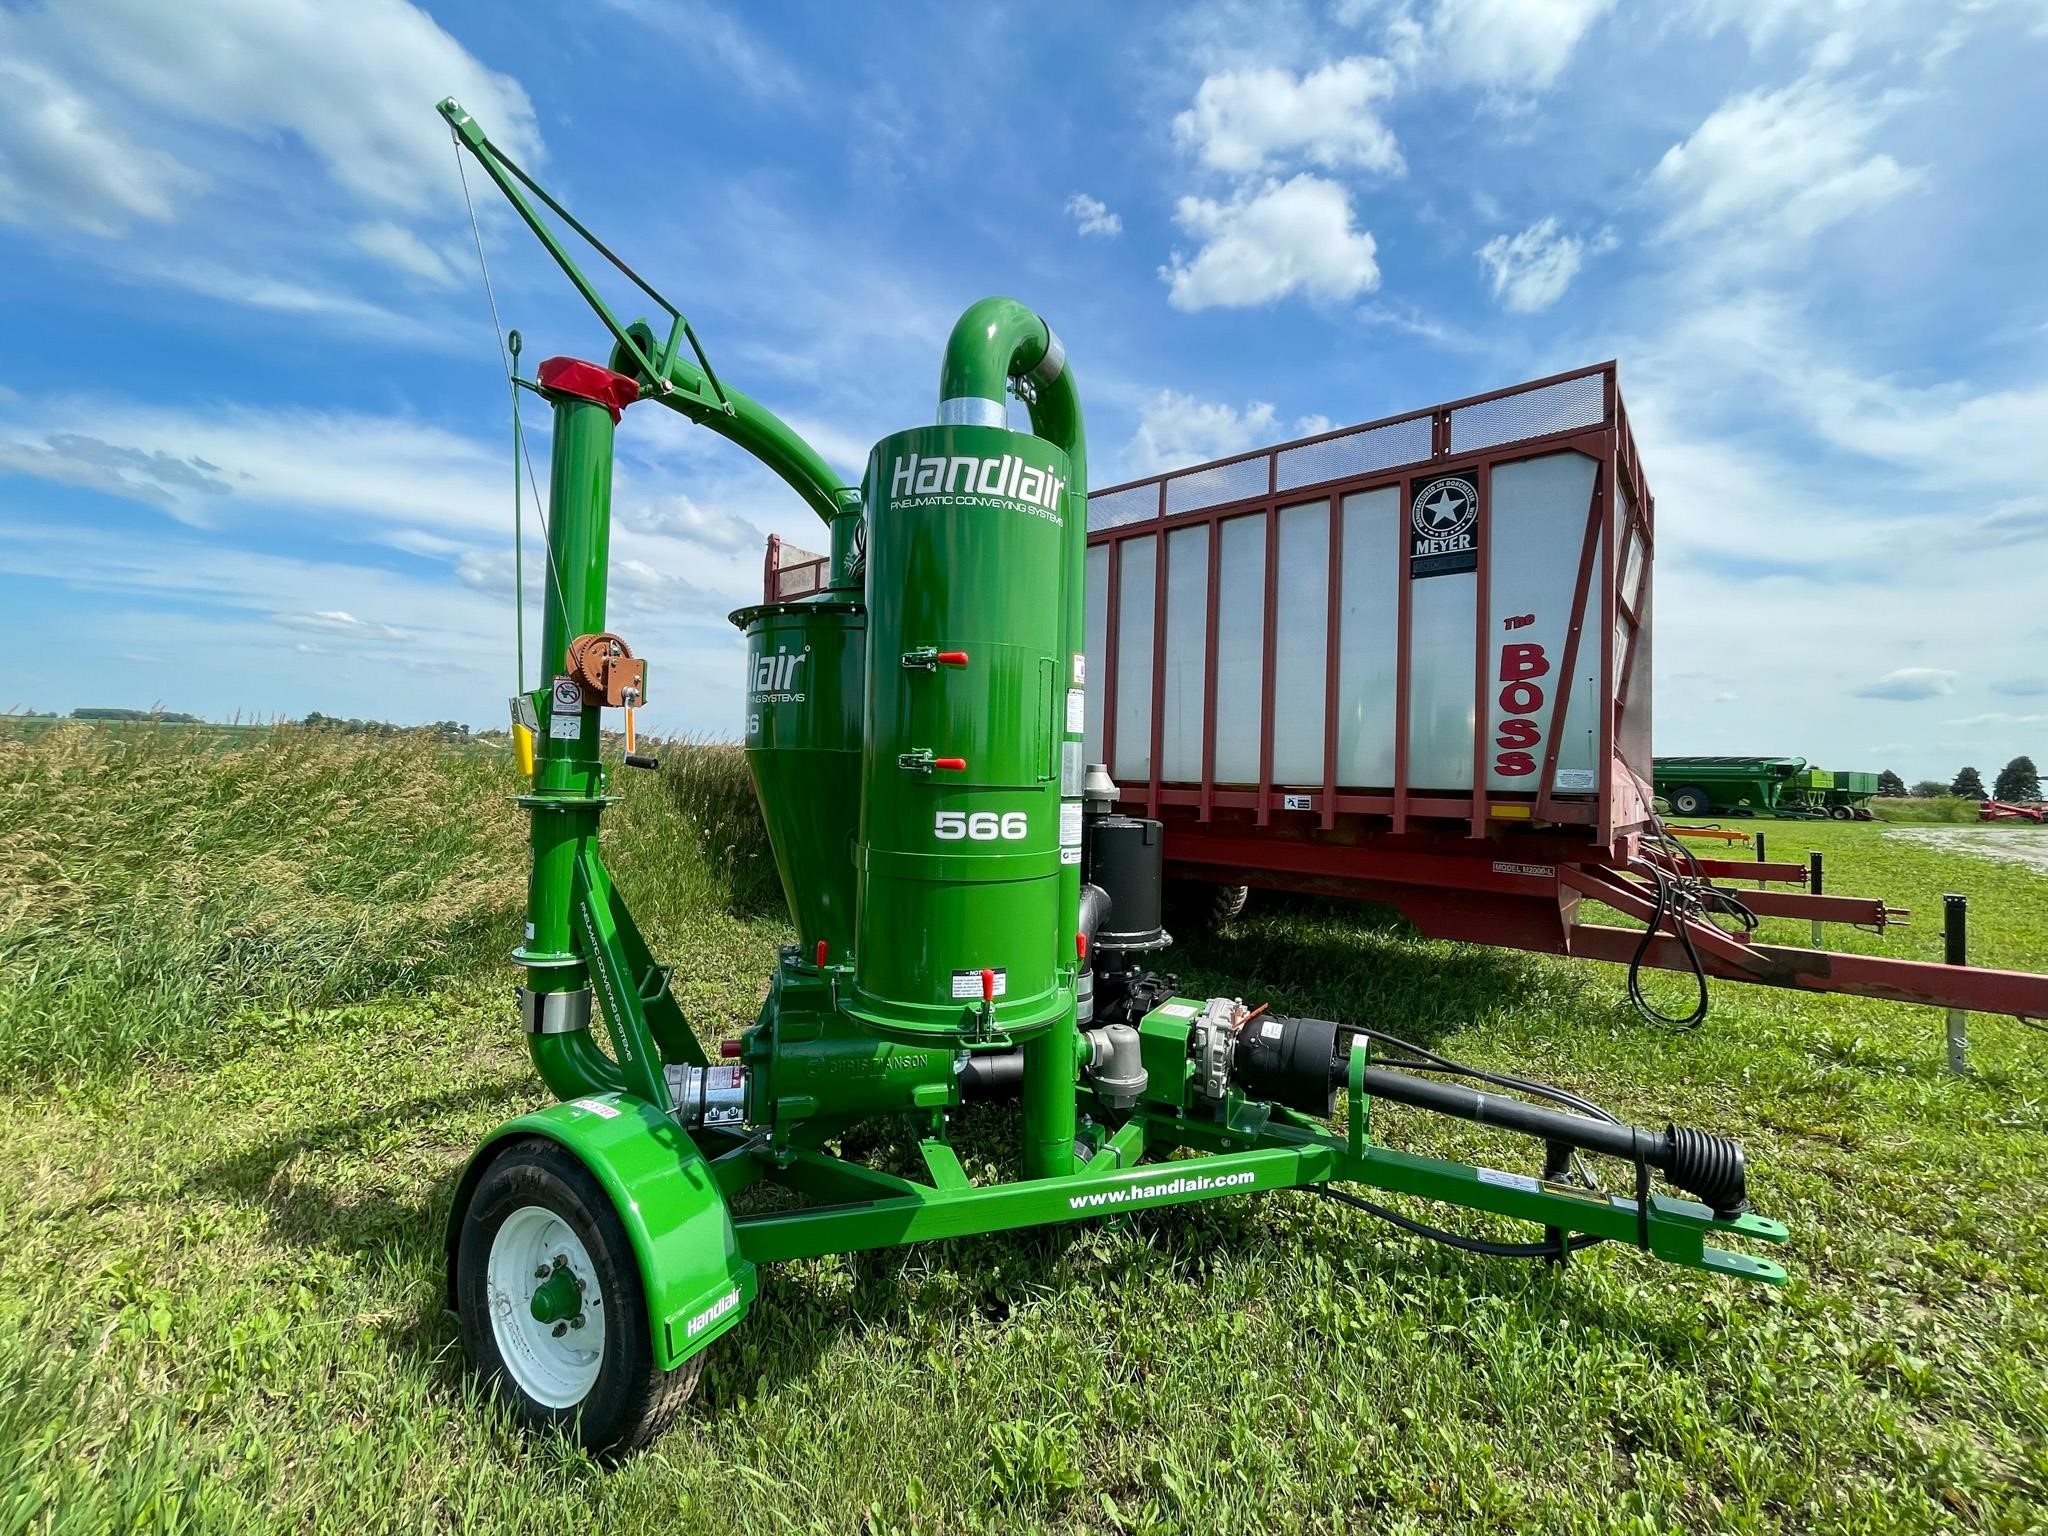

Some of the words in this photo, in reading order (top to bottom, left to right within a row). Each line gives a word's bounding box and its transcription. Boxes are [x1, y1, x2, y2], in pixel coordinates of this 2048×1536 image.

[891, 453, 1065, 512] Handlair
[890, 496, 953, 511] PNEUMATIC
[955, 496, 1027, 513] CONVEYING
[1027, 506, 1064, 528] SYSTEMS
[1416, 534, 1471, 555] MEYER
[1503, 613, 1536, 631] The
[762, 693, 806, 703] SYSTEMS
[1494, 643, 1550, 777] BOSS
[934, 810, 1028, 841] 566
[1495, 863, 1521, 872] MODEL
[579, 901, 600, 956] PNEUMATIC
[597, 956, 617, 1014] CONVEYING
[614, 1013, 633, 1062] SYSTEMS
[1069, 1171, 1256, 1209] www.handlair.com
[687, 1287, 742, 1338] Handlair
